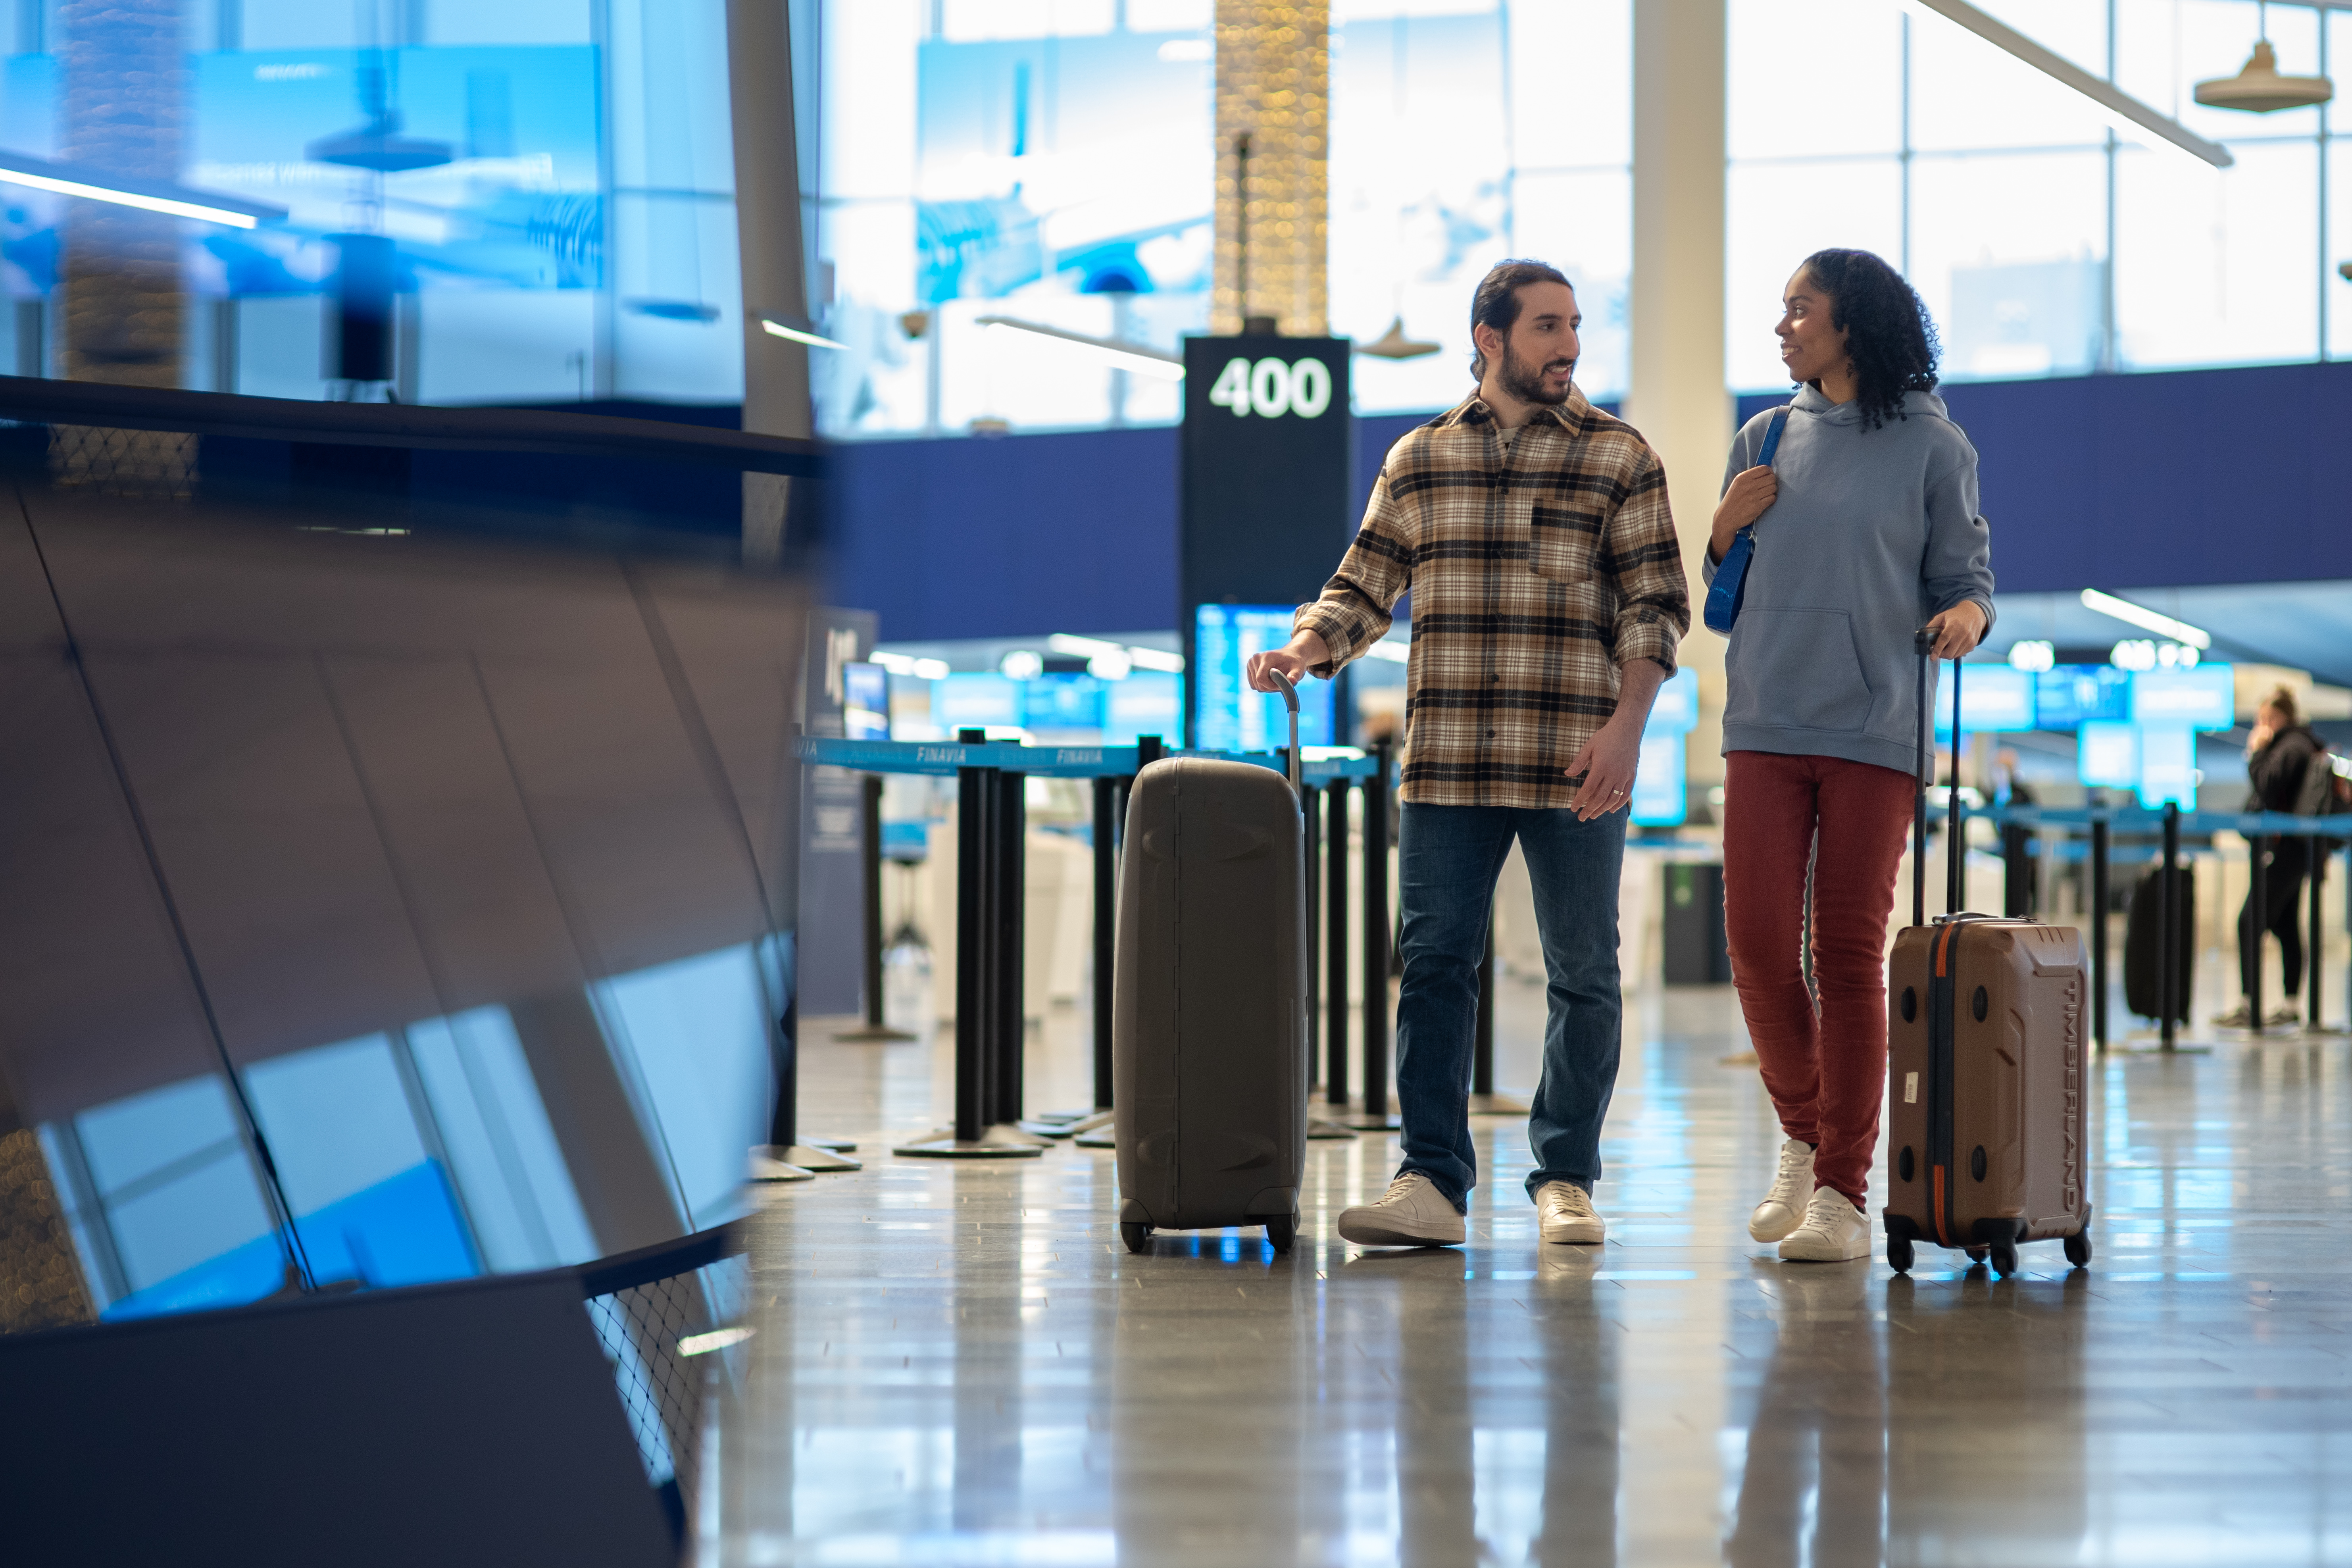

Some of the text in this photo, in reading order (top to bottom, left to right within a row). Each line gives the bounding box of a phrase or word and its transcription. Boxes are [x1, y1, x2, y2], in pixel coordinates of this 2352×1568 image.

[1209, 357, 1332, 419] 400
[916, 746, 967, 763] FINAVIA
[2064, 980, 2077, 1211] TIMBERLAND
